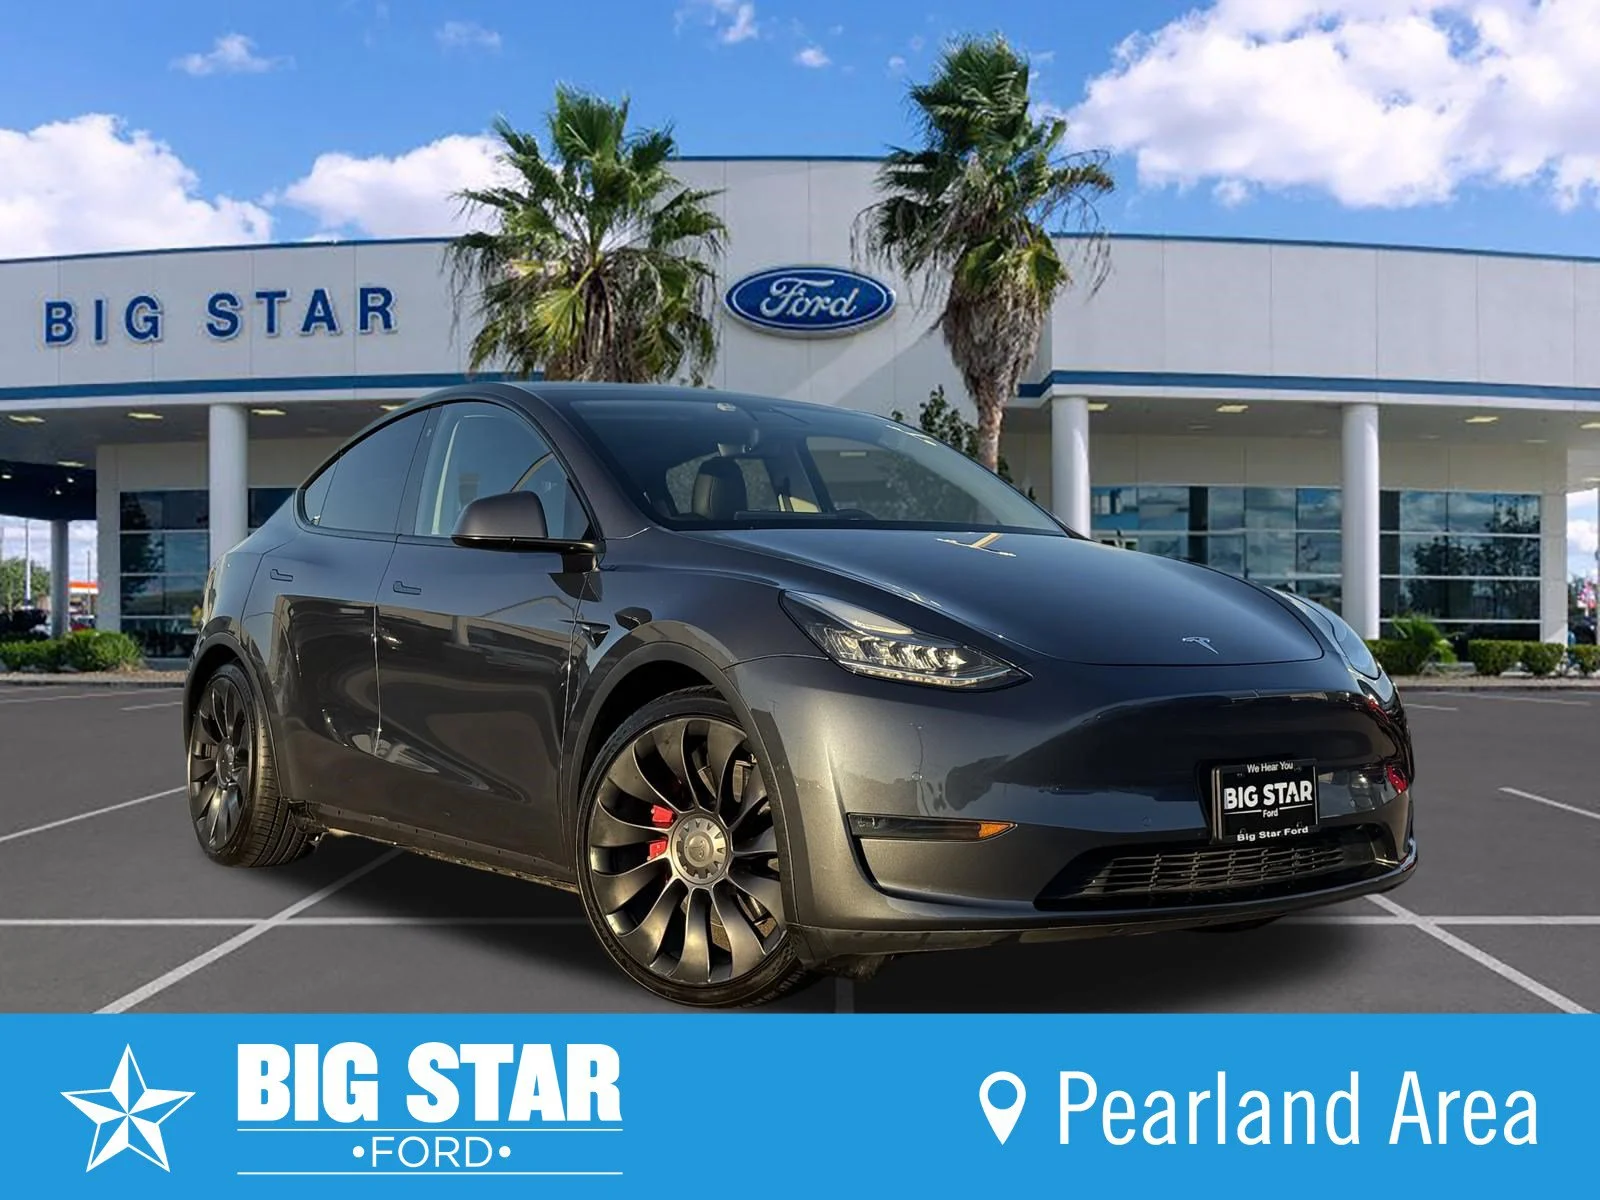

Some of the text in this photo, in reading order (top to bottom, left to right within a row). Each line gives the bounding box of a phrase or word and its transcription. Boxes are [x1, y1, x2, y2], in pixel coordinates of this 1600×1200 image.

[759, 277, 859, 318] Ford
[43, 286, 397, 346] BIG STAR
[1246, 761, 1294, 773] We Hear You
[1223, 780, 1313, 810] BIG STAR
[1262, 808, 1279, 818] Ford
[1236, 826, 1309, 842] Big Star Ford
